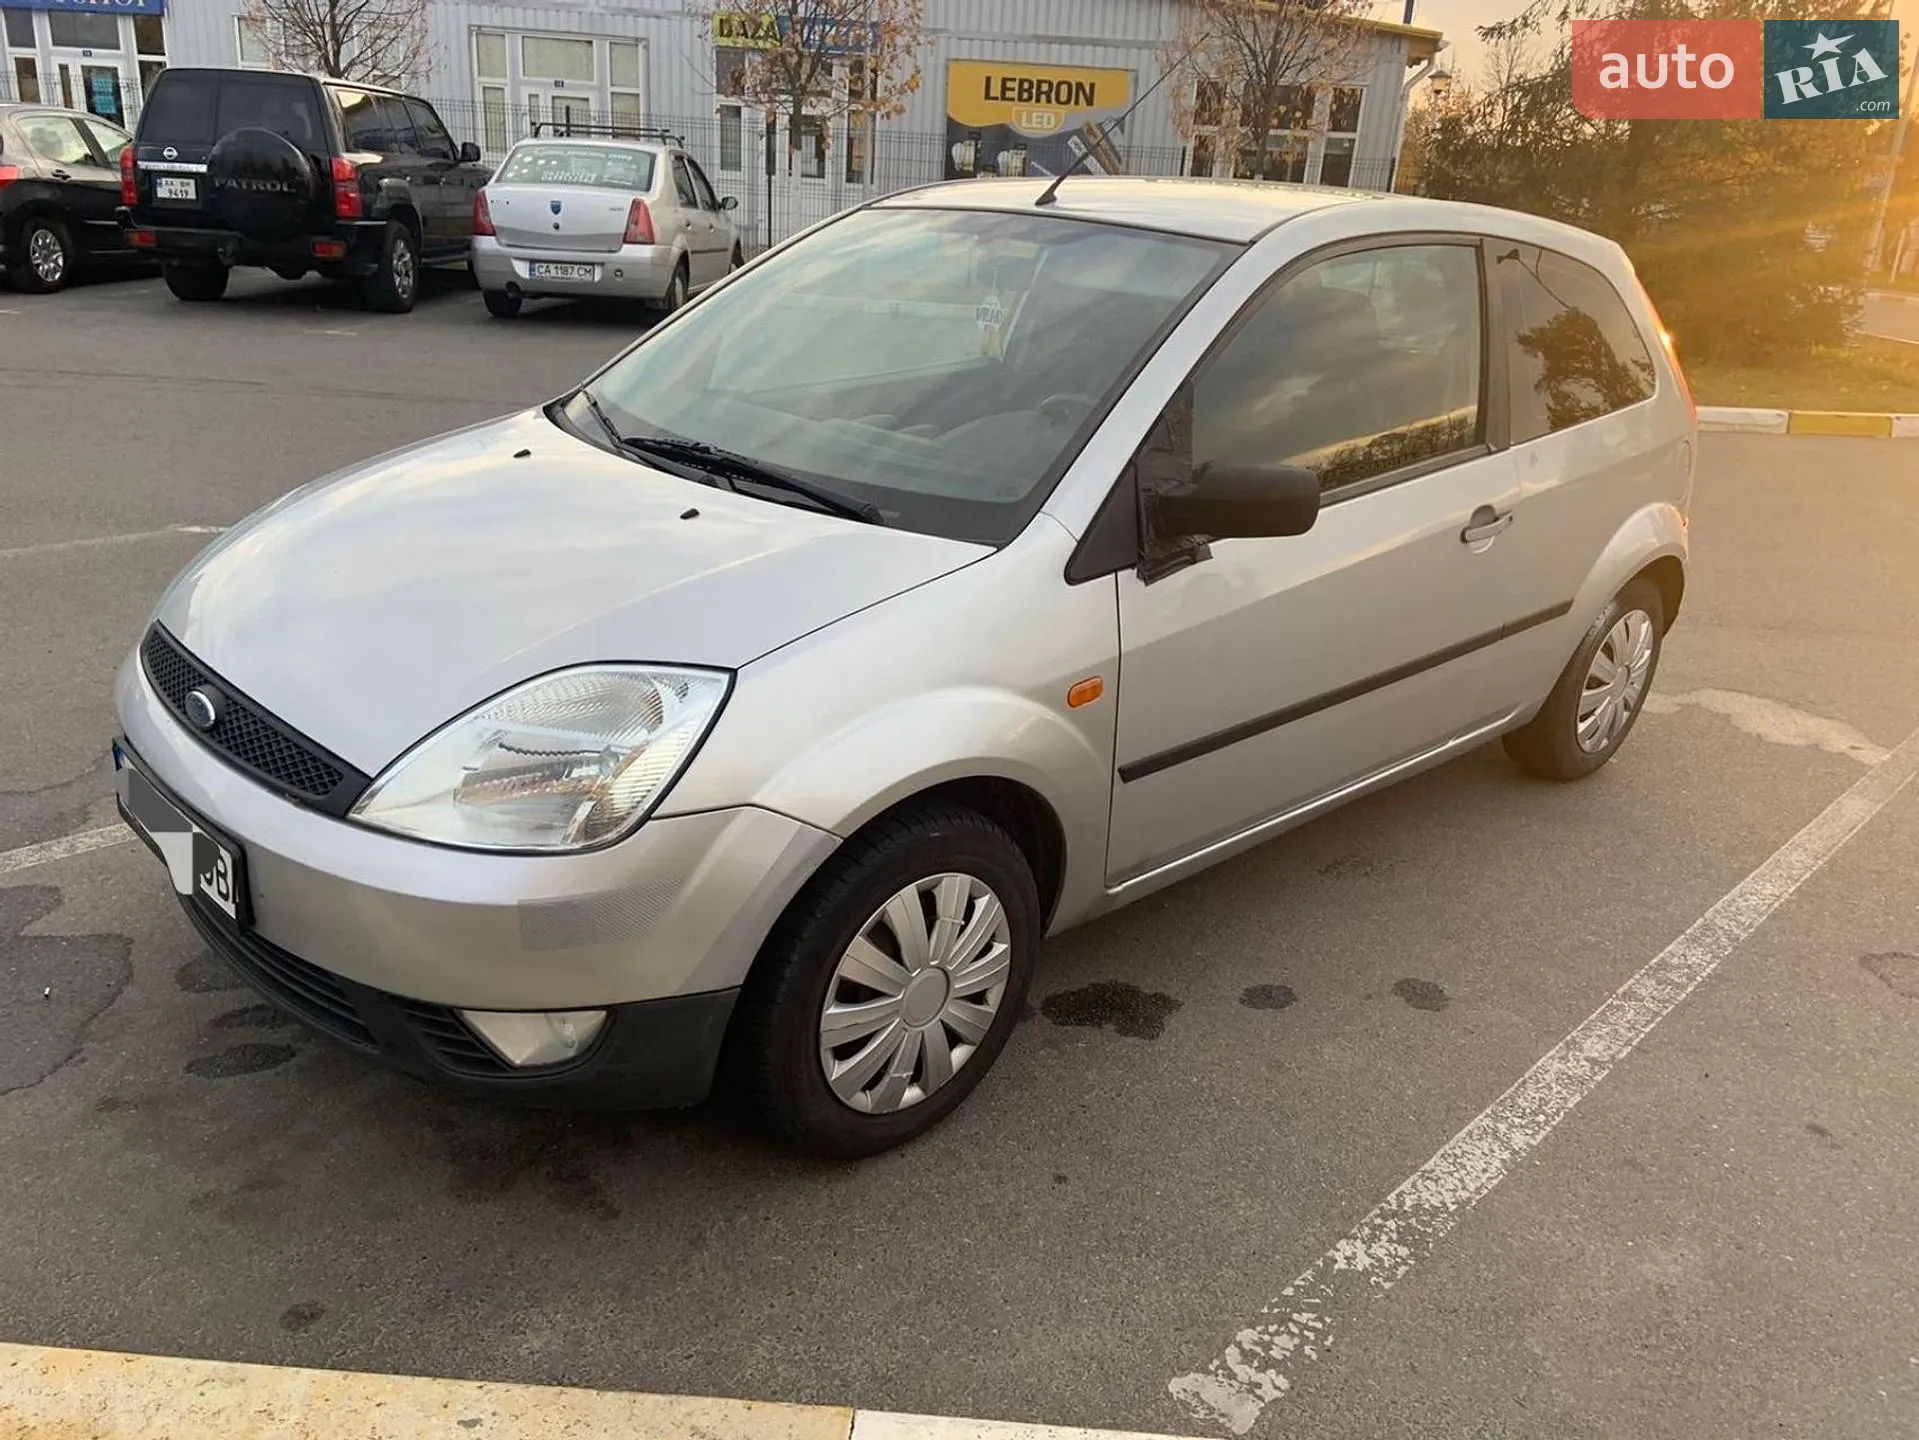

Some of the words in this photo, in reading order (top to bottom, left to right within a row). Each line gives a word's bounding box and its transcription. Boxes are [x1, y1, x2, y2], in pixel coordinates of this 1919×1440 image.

[984, 76, 1096, 106] LEBRON
[1021, 111, 1054, 129] LED
[214, 177, 297, 192] PATROL
[537, 264, 551, 275] CA
[577, 266, 592, 277] CM
